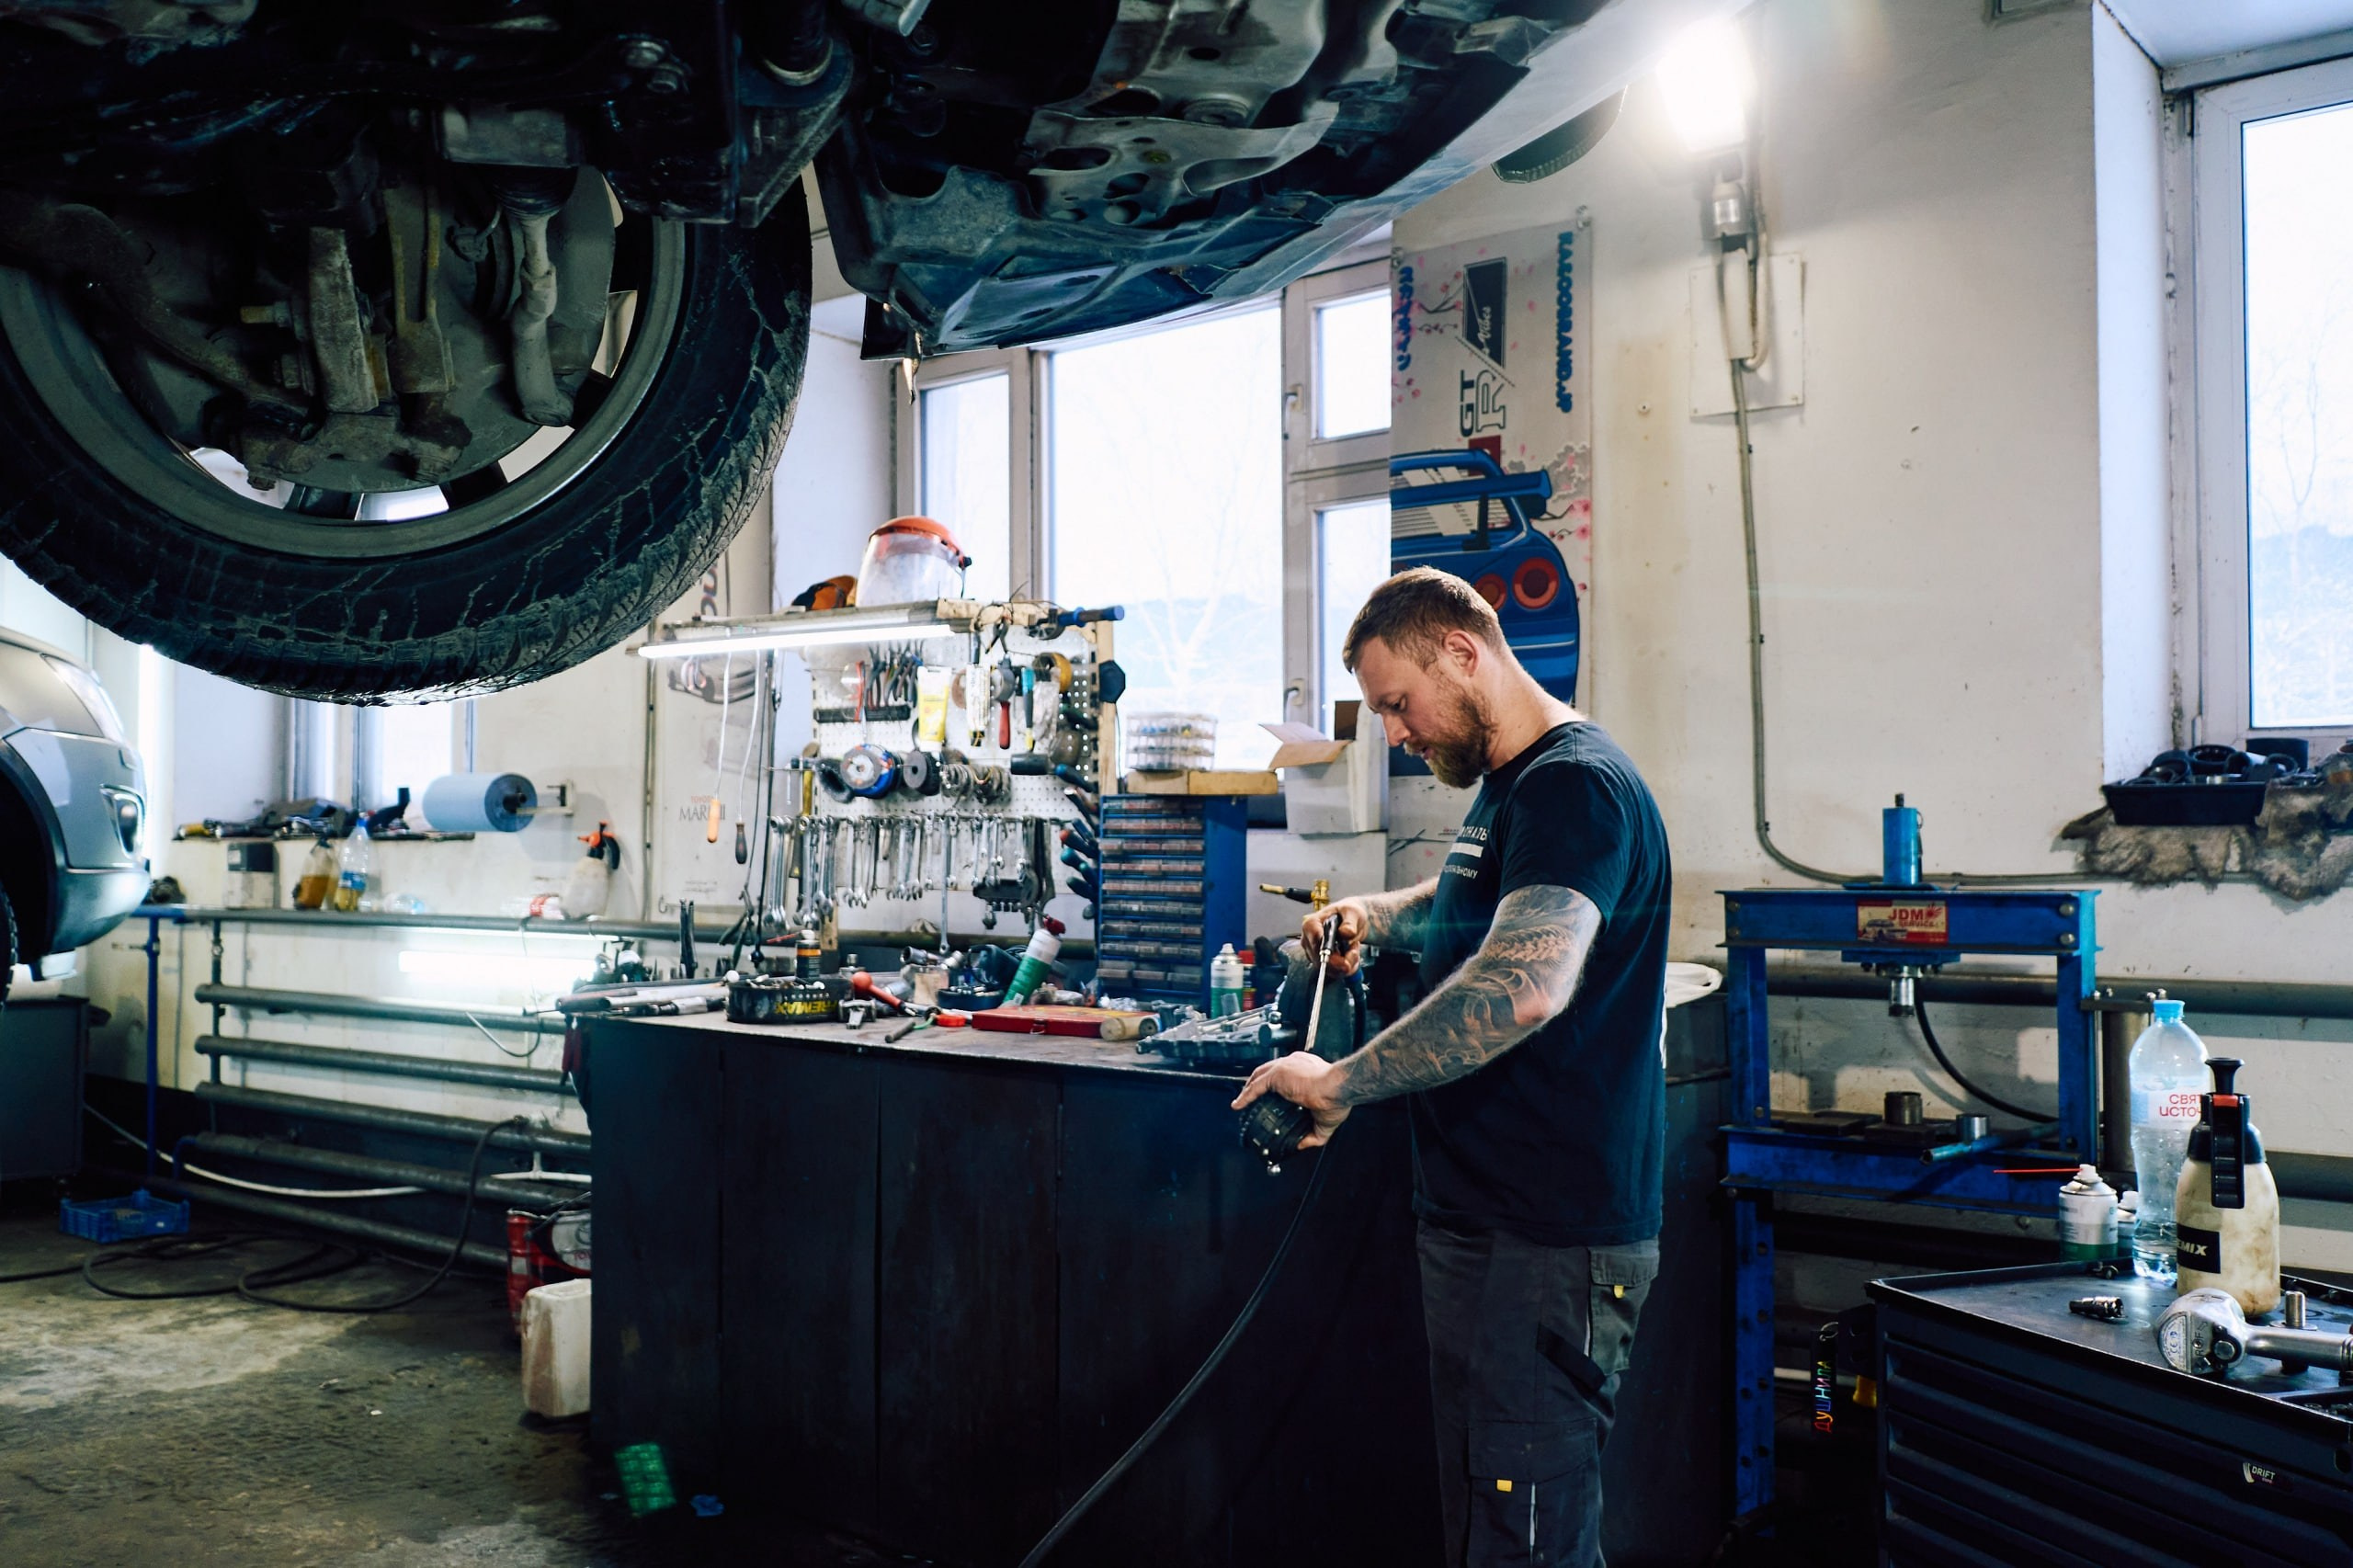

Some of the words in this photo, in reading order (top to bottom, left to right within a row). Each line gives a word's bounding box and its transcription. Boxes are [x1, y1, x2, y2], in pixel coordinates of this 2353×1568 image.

[1460, 369, 1474, 437] GT
[1888, 908, 1924, 921] JDM
[2251, 1465, 2276, 1481] DRIFT
